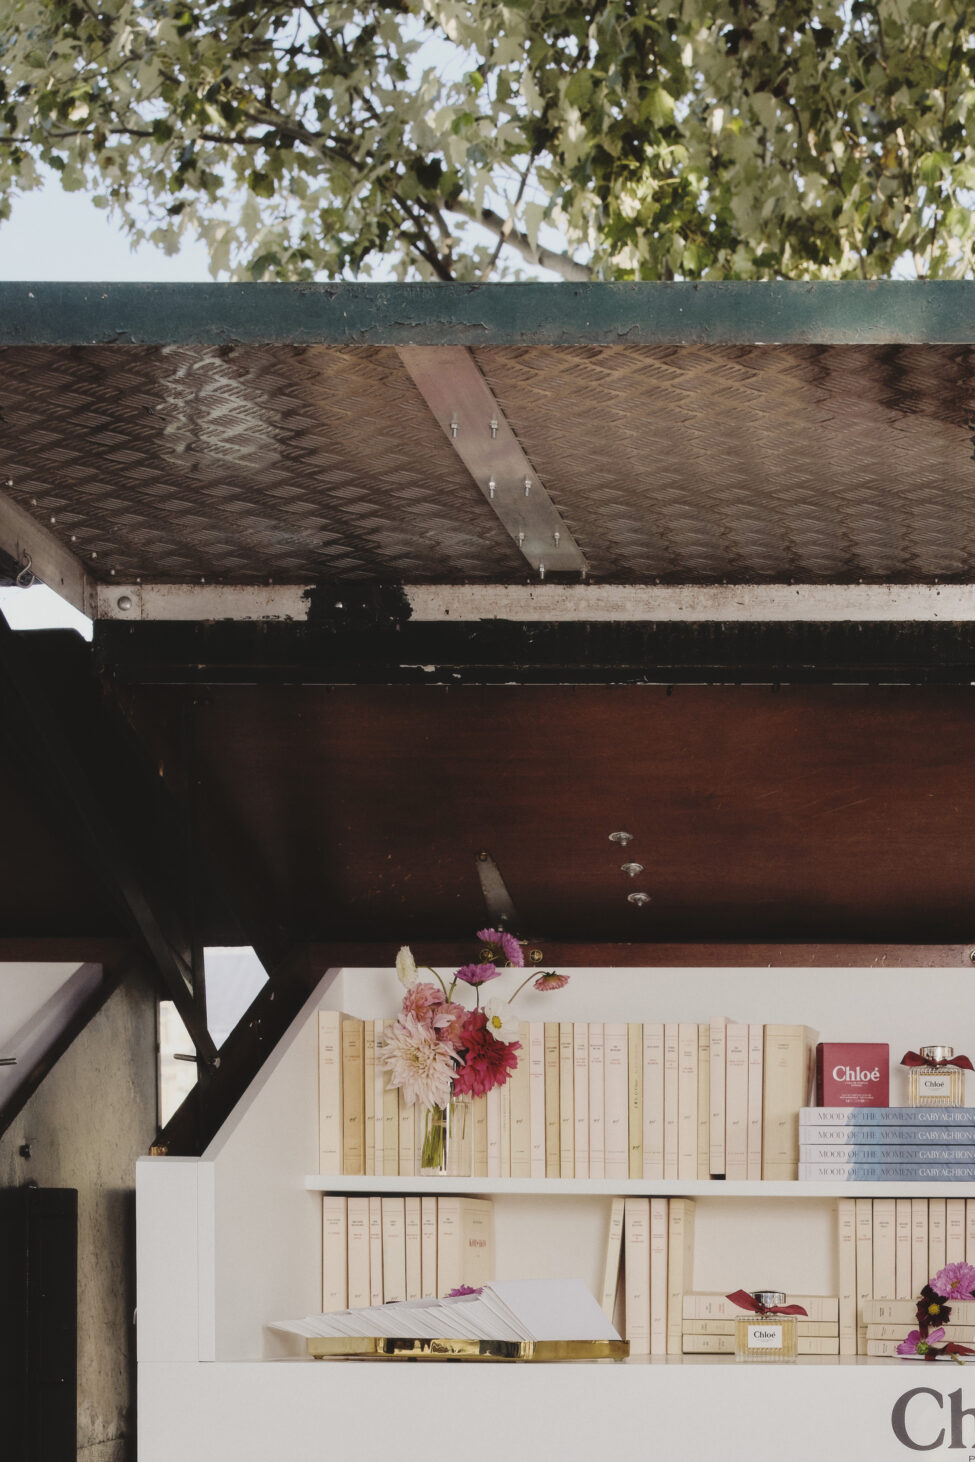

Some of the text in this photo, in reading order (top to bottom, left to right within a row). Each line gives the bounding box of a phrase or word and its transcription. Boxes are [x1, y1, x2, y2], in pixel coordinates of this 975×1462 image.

[832, 1065, 881, 1082] Chloé
[924, 1079, 945, 1088] Chloé
[817, 1112, 845, 1121] MOOD
[847, 1112, 858, 1121] OF
[862, 1112, 876, 1121] THE
[880, 1112, 916, 1121] MOMENT
[918, 1112, 939, 1121] GABY
[941, 1112, 973, 1121] AGHION
[818, 1131, 845, 1140] MOOD
[847, 1131, 858, 1140] OF
[862, 1131, 876, 1140] THE
[880, 1131, 916, 1140] MOMENT
[918, 1131, 939, 1140] GABY
[941, 1131, 973, 1140] AGHION
[818, 1150, 846, 1159] MOOD
[847, 1150, 858, 1159] OF
[863, 1150, 877, 1159] THE
[881, 1150, 918, 1159] MOMENT
[919, 1150, 939, 1159] GABY
[941, 1150, 973, 1159] AGHION
[818, 1168, 846, 1177] MOOD
[847, 1168, 858, 1177] OF
[863, 1168, 877, 1177] THE
[881, 1168, 918, 1177] MOMENT
[919, 1168, 939, 1177] GABY
[941, 1168, 973, 1177] AGHION
[753, 1330, 776, 1339] Chloé
